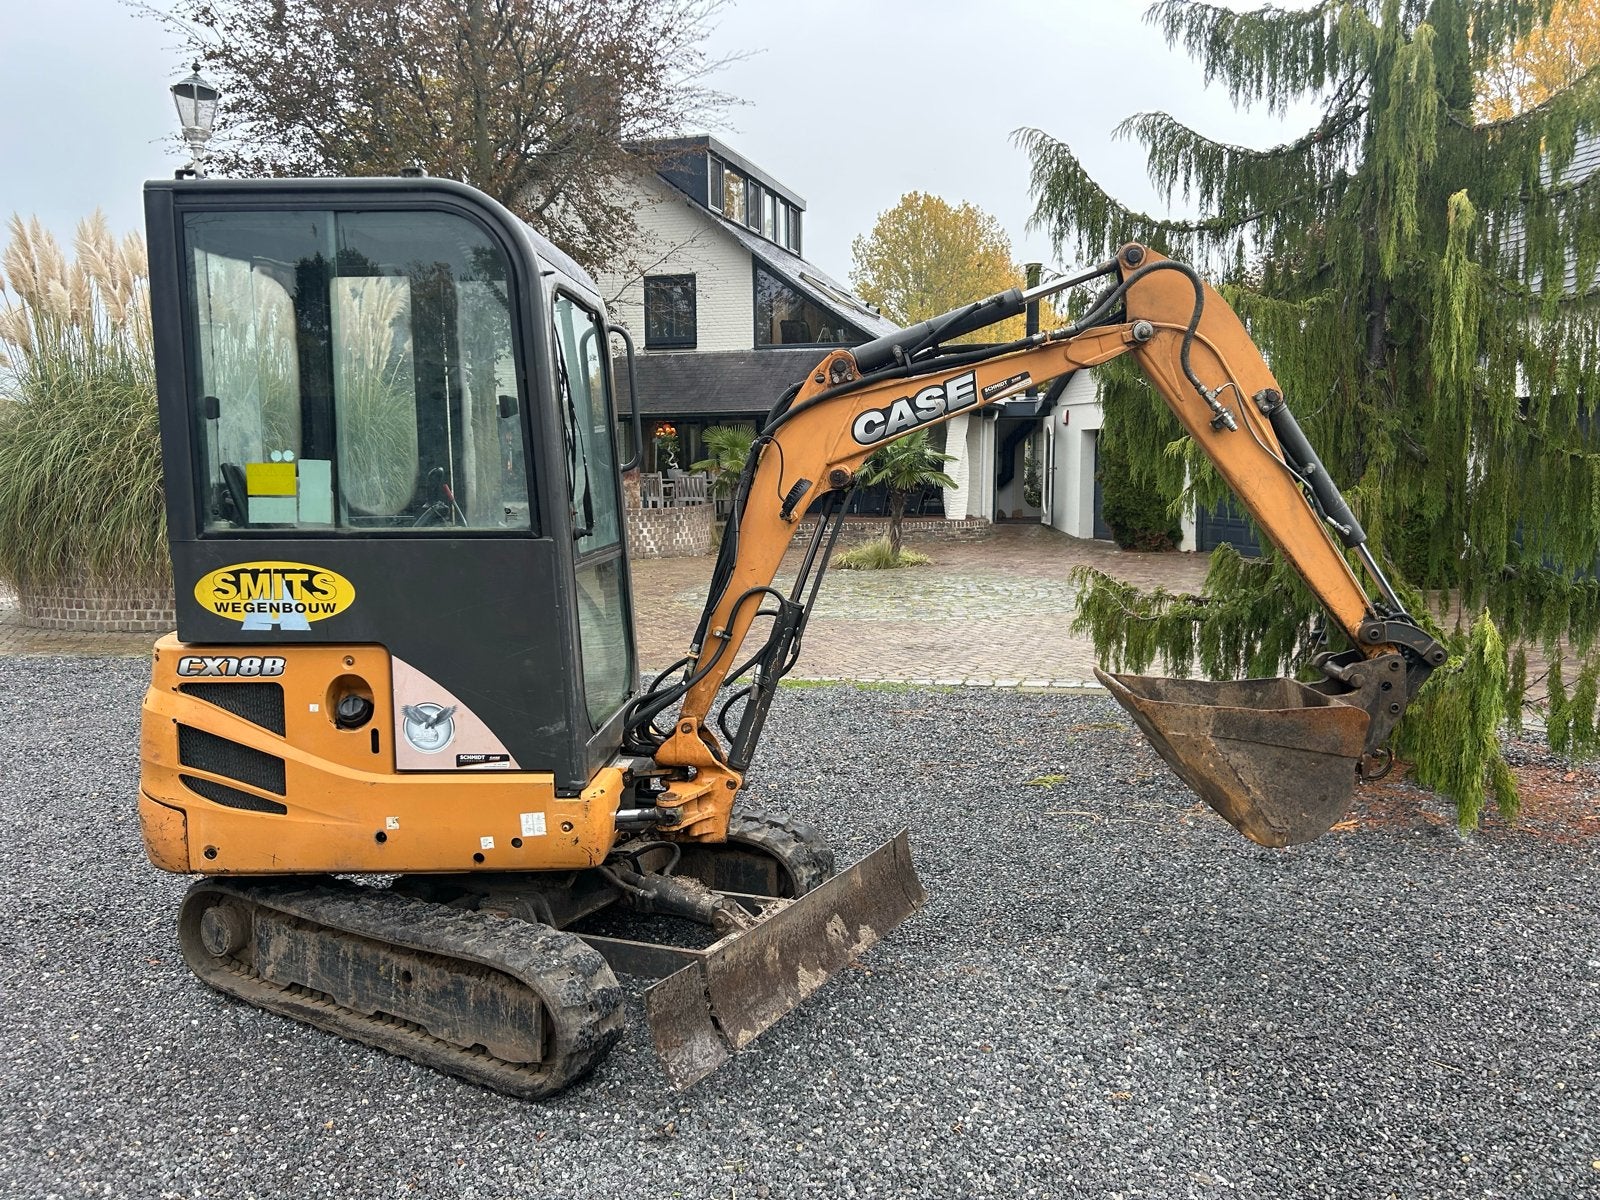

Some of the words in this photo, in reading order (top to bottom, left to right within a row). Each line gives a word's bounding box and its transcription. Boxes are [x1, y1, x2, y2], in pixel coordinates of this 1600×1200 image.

[984, 380, 1008, 393] SCHMIDT
[853, 372, 976, 445] CASE
[212, 571, 337, 601] SMITS
[214, 602, 337, 614] WEGENBOUW
[178, 656, 287, 676] CX18B
